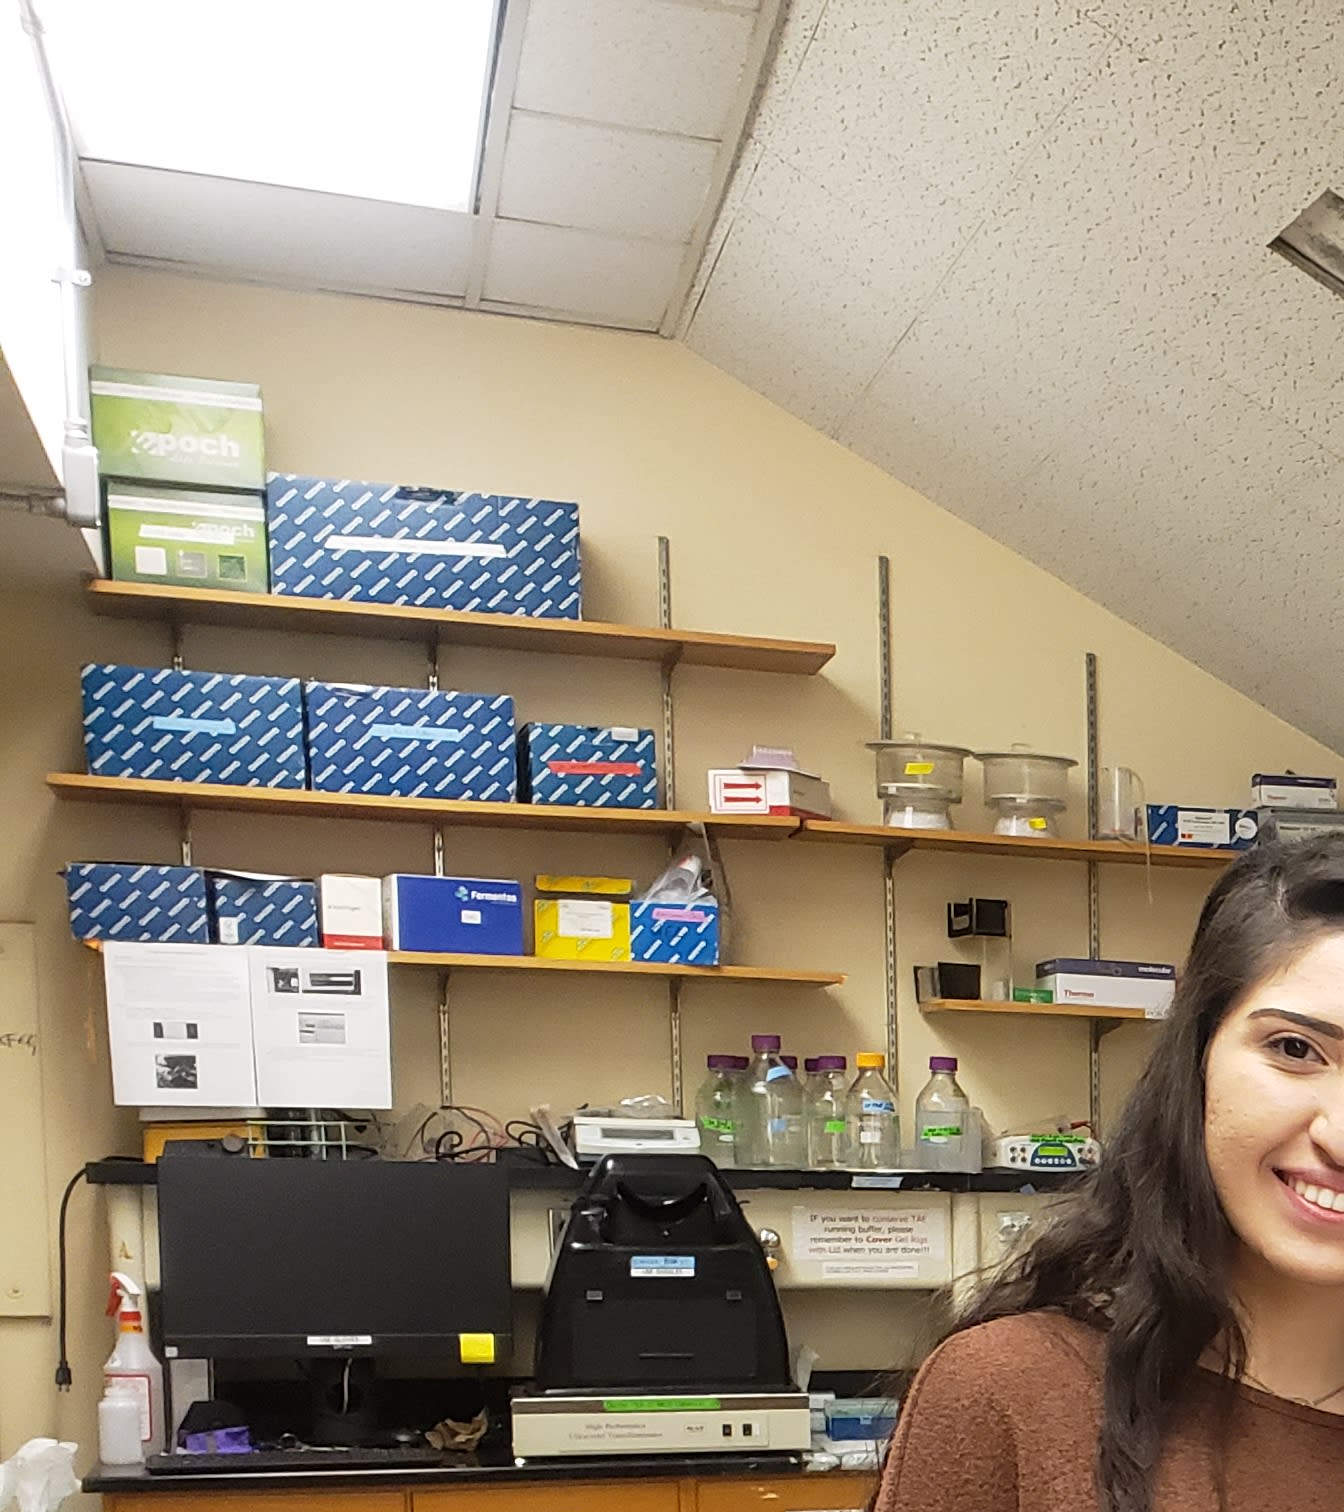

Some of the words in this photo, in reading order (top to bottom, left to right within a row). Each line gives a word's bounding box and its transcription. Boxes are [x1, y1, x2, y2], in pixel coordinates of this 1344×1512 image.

[821, 1215, 837, 1224] you
[861, 1214, 870, 1222] to
[824, 1226, 855, 1234] running
[887, 1226, 914, 1234] please
[865, 1236, 893, 1244] Cover
[868, 1247, 883, 1255] you
